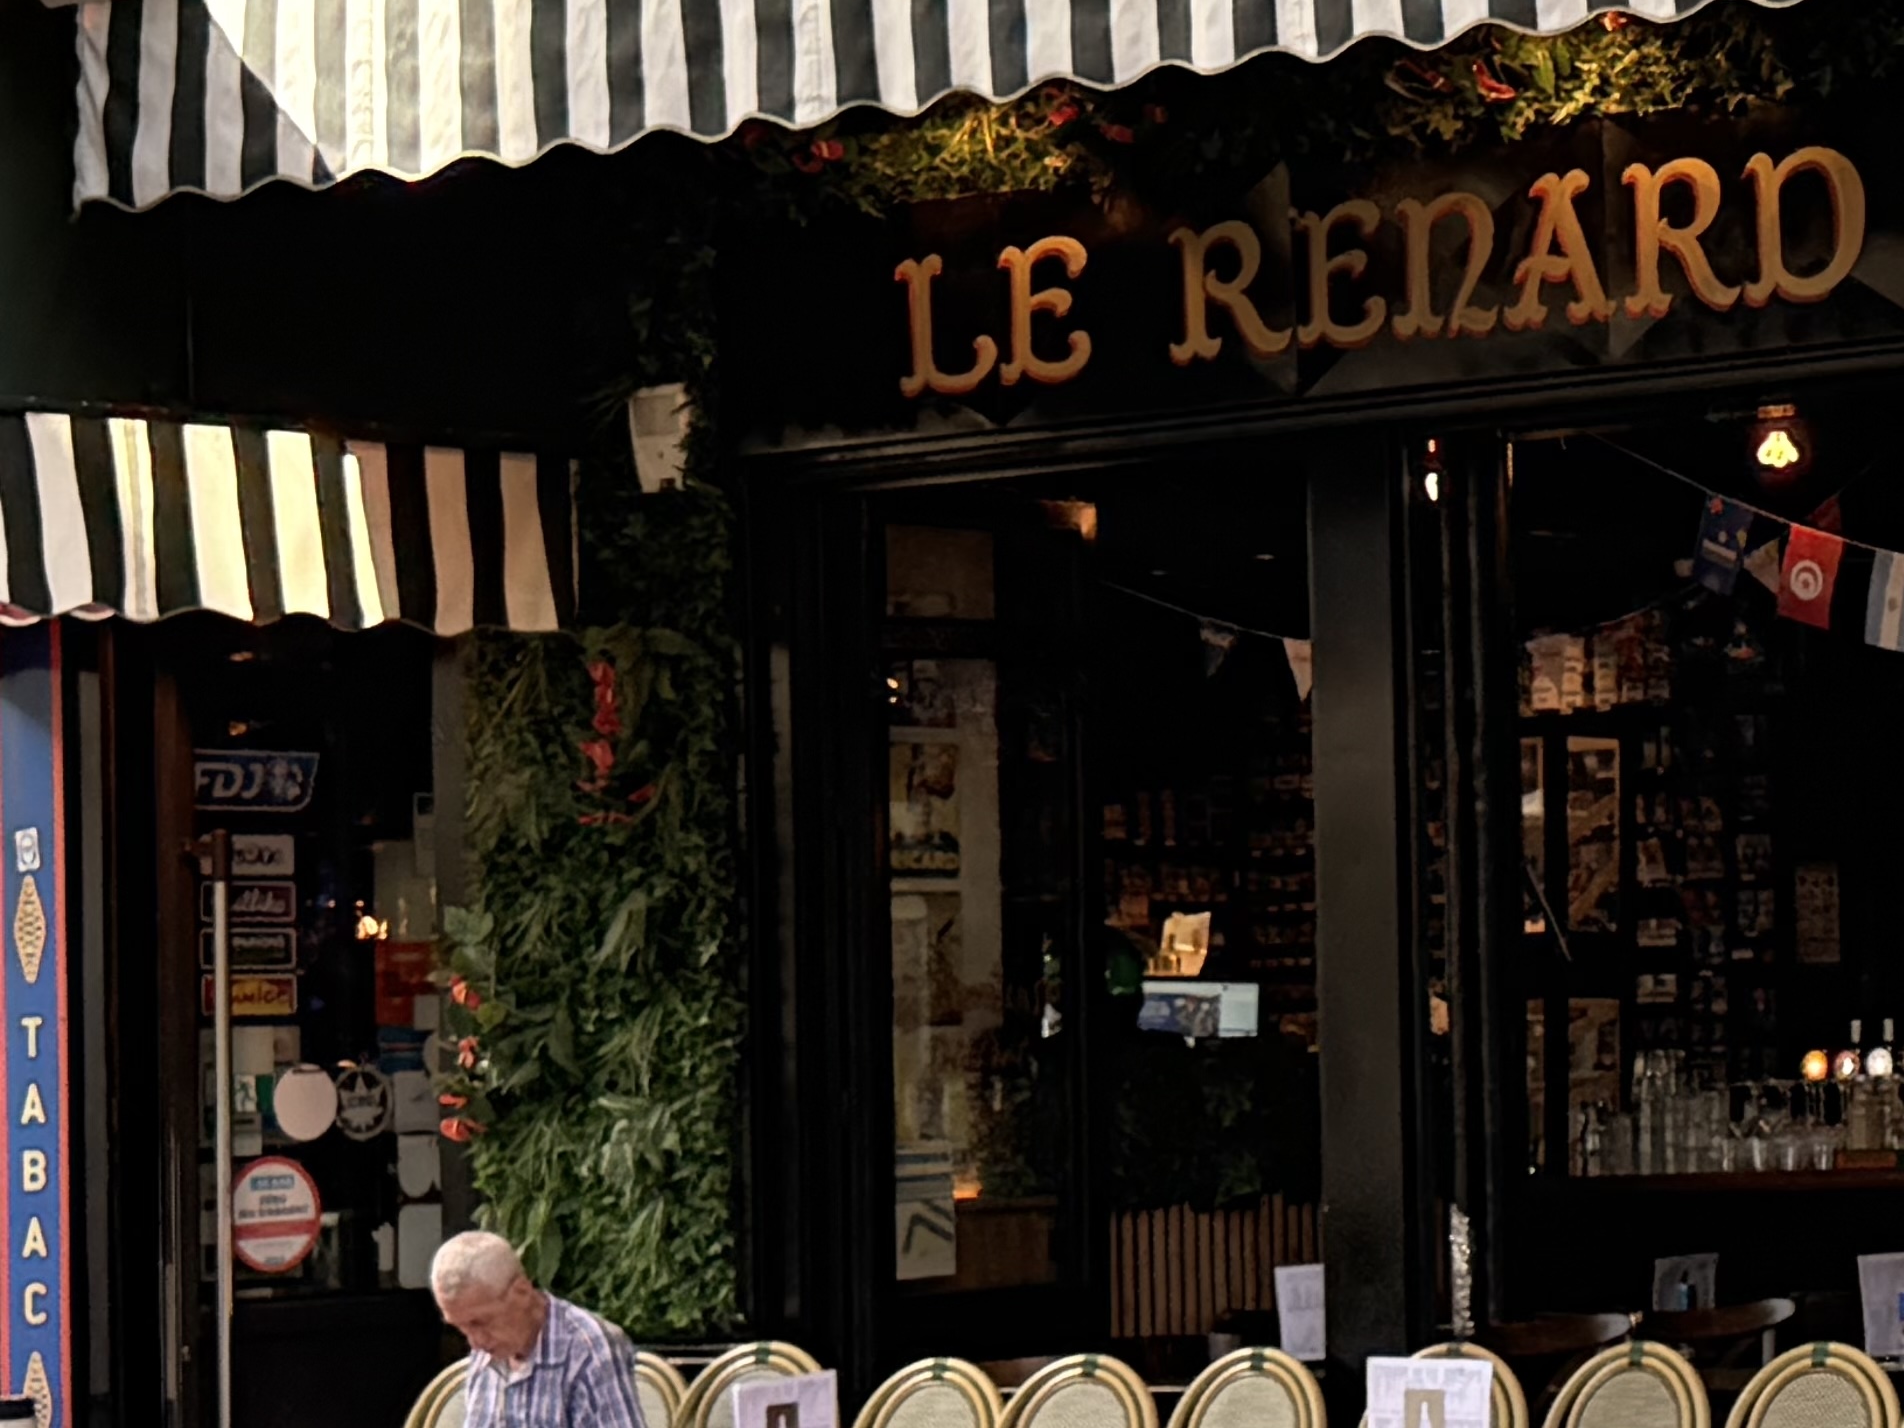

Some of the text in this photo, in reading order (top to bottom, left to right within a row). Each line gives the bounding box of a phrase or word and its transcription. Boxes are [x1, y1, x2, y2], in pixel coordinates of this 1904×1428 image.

[894, 145, 1867, 398] LE RENARD
[20, 1016, 48, 1326] TABAC
